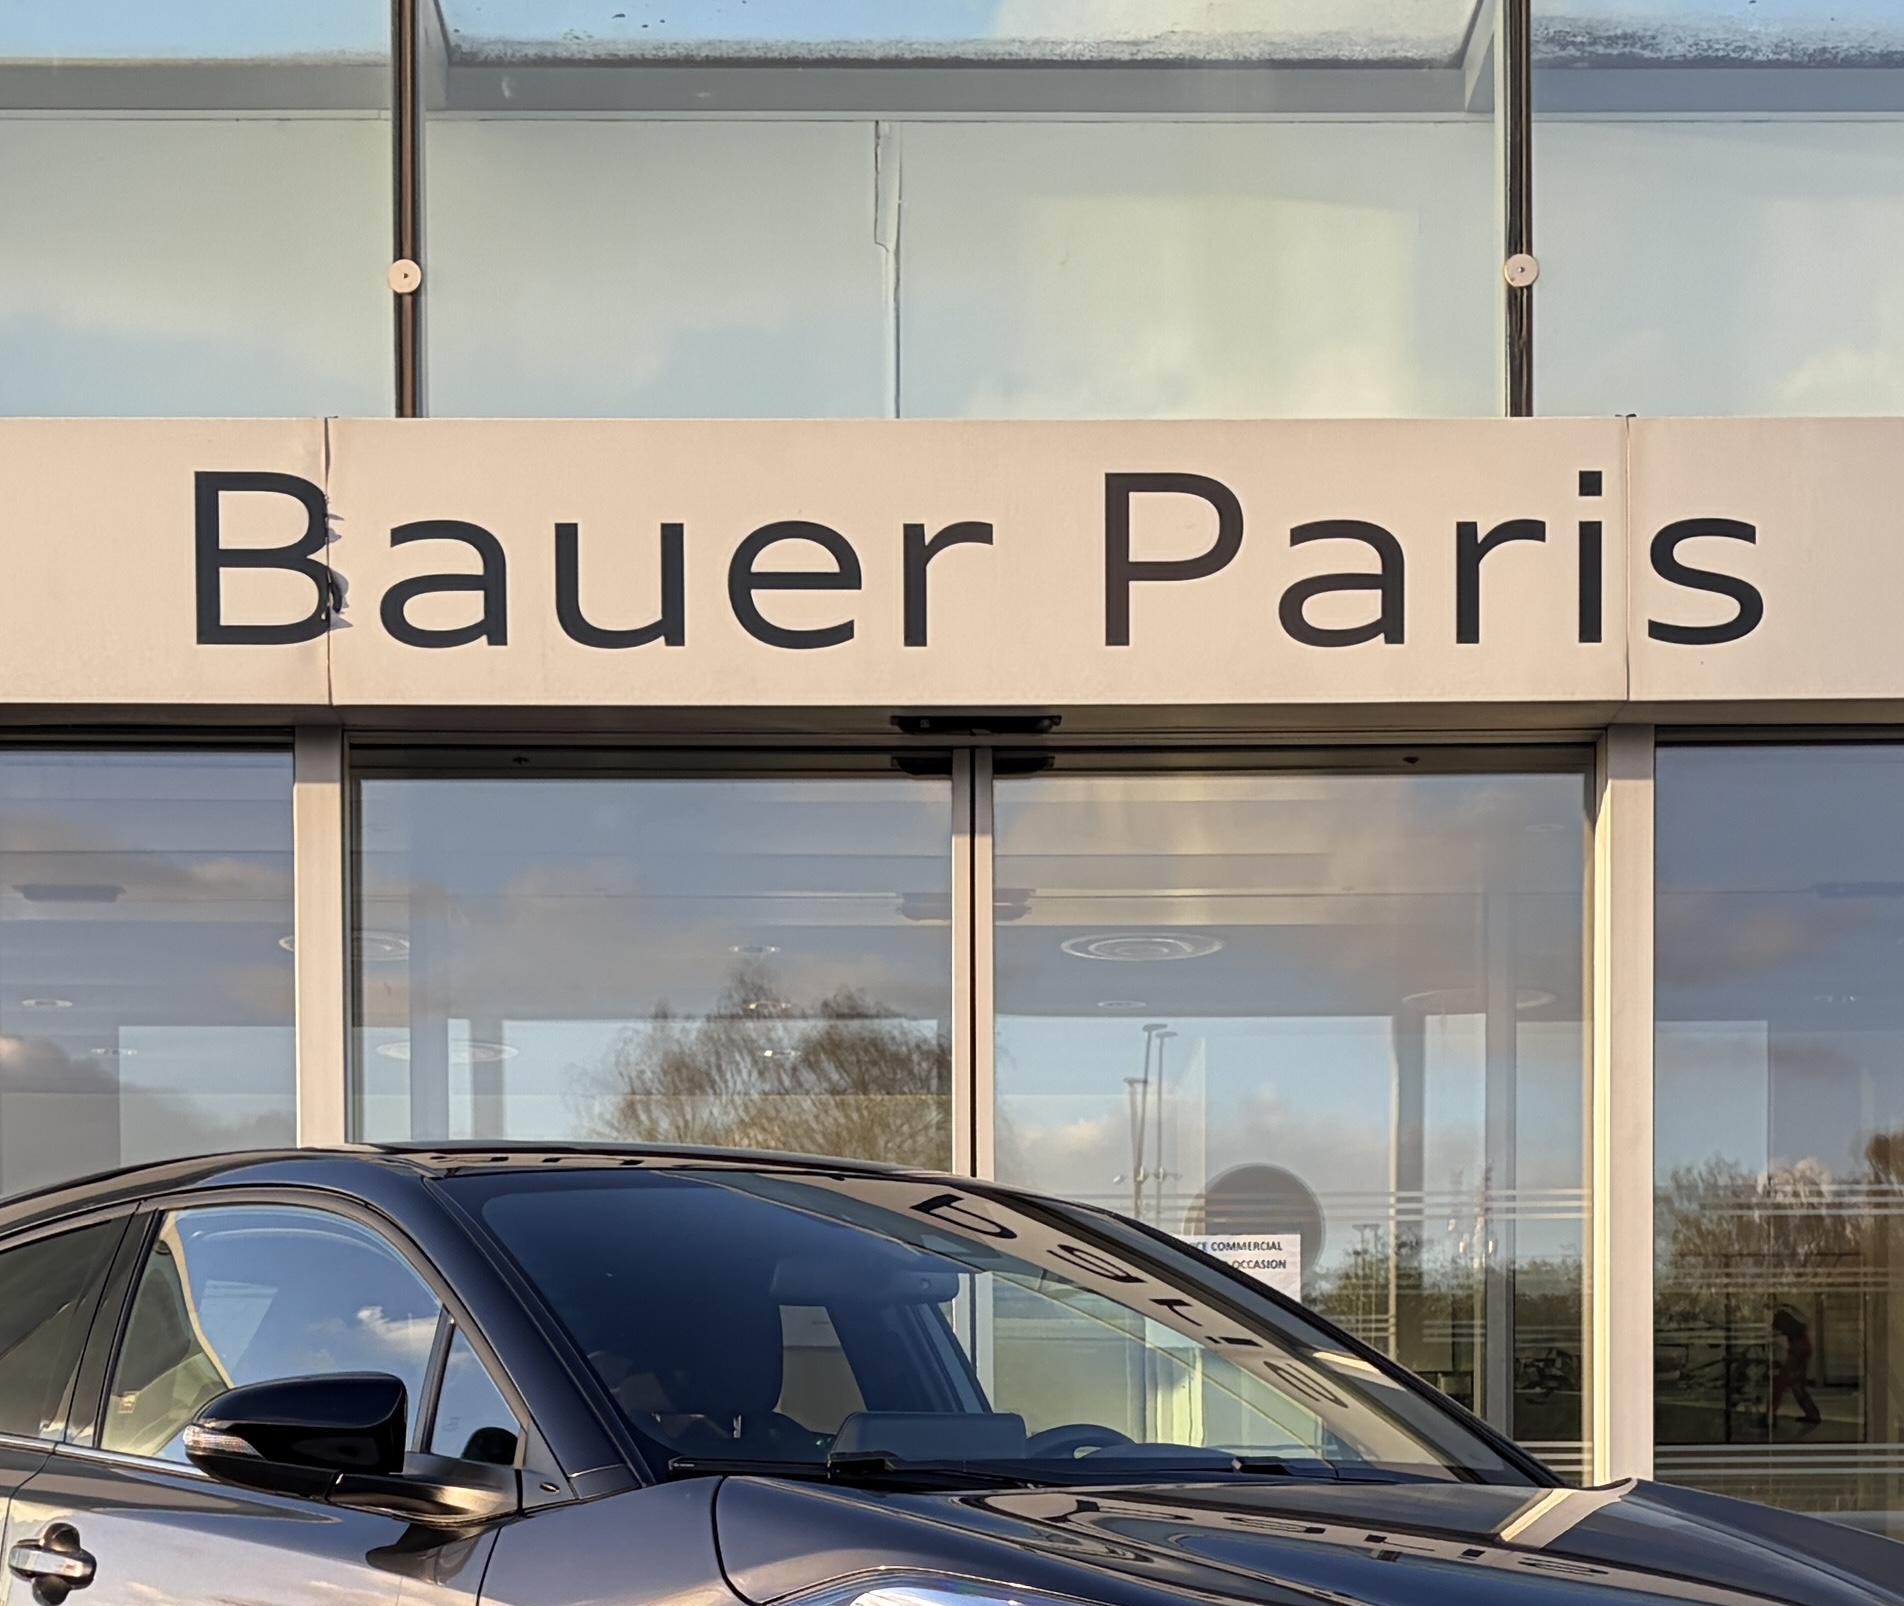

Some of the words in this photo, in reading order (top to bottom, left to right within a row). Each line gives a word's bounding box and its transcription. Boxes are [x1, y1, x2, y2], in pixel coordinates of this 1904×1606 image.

[192, 470, 994, 649] Bauer
[1106, 472, 1764, 648] Paris
[1210, 1241, 1283, 1251] COMMERCIAL
[1232, 1259, 1287, 1269] OCCASION
